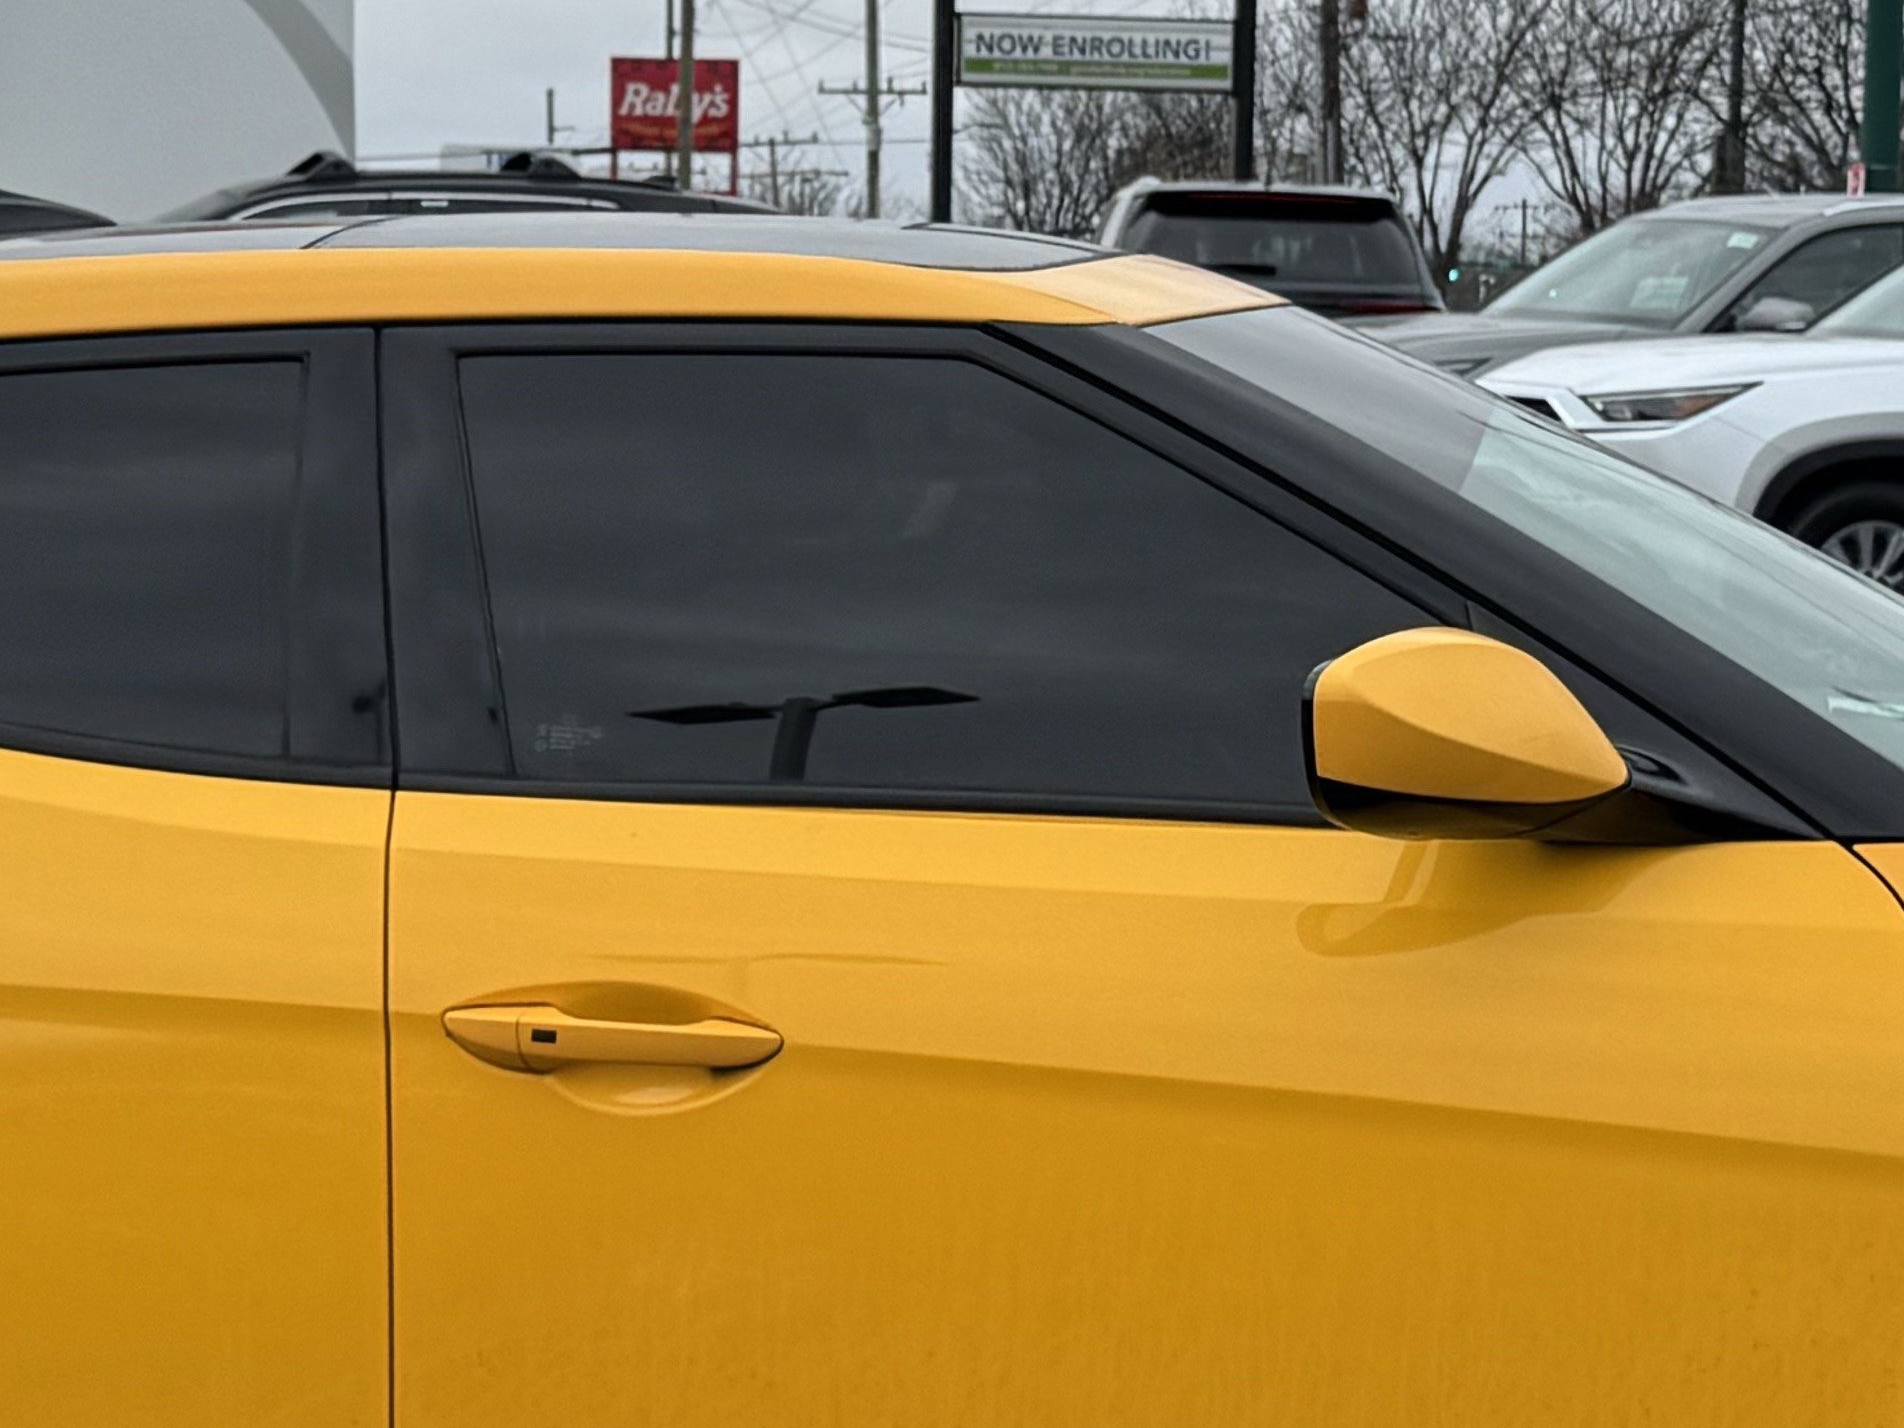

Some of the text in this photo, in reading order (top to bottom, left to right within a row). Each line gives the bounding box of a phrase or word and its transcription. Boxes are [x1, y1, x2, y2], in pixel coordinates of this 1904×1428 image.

[975, 32, 1211, 61] NOW ENROLLING!
[618, 81, 730, 124] Raly's
